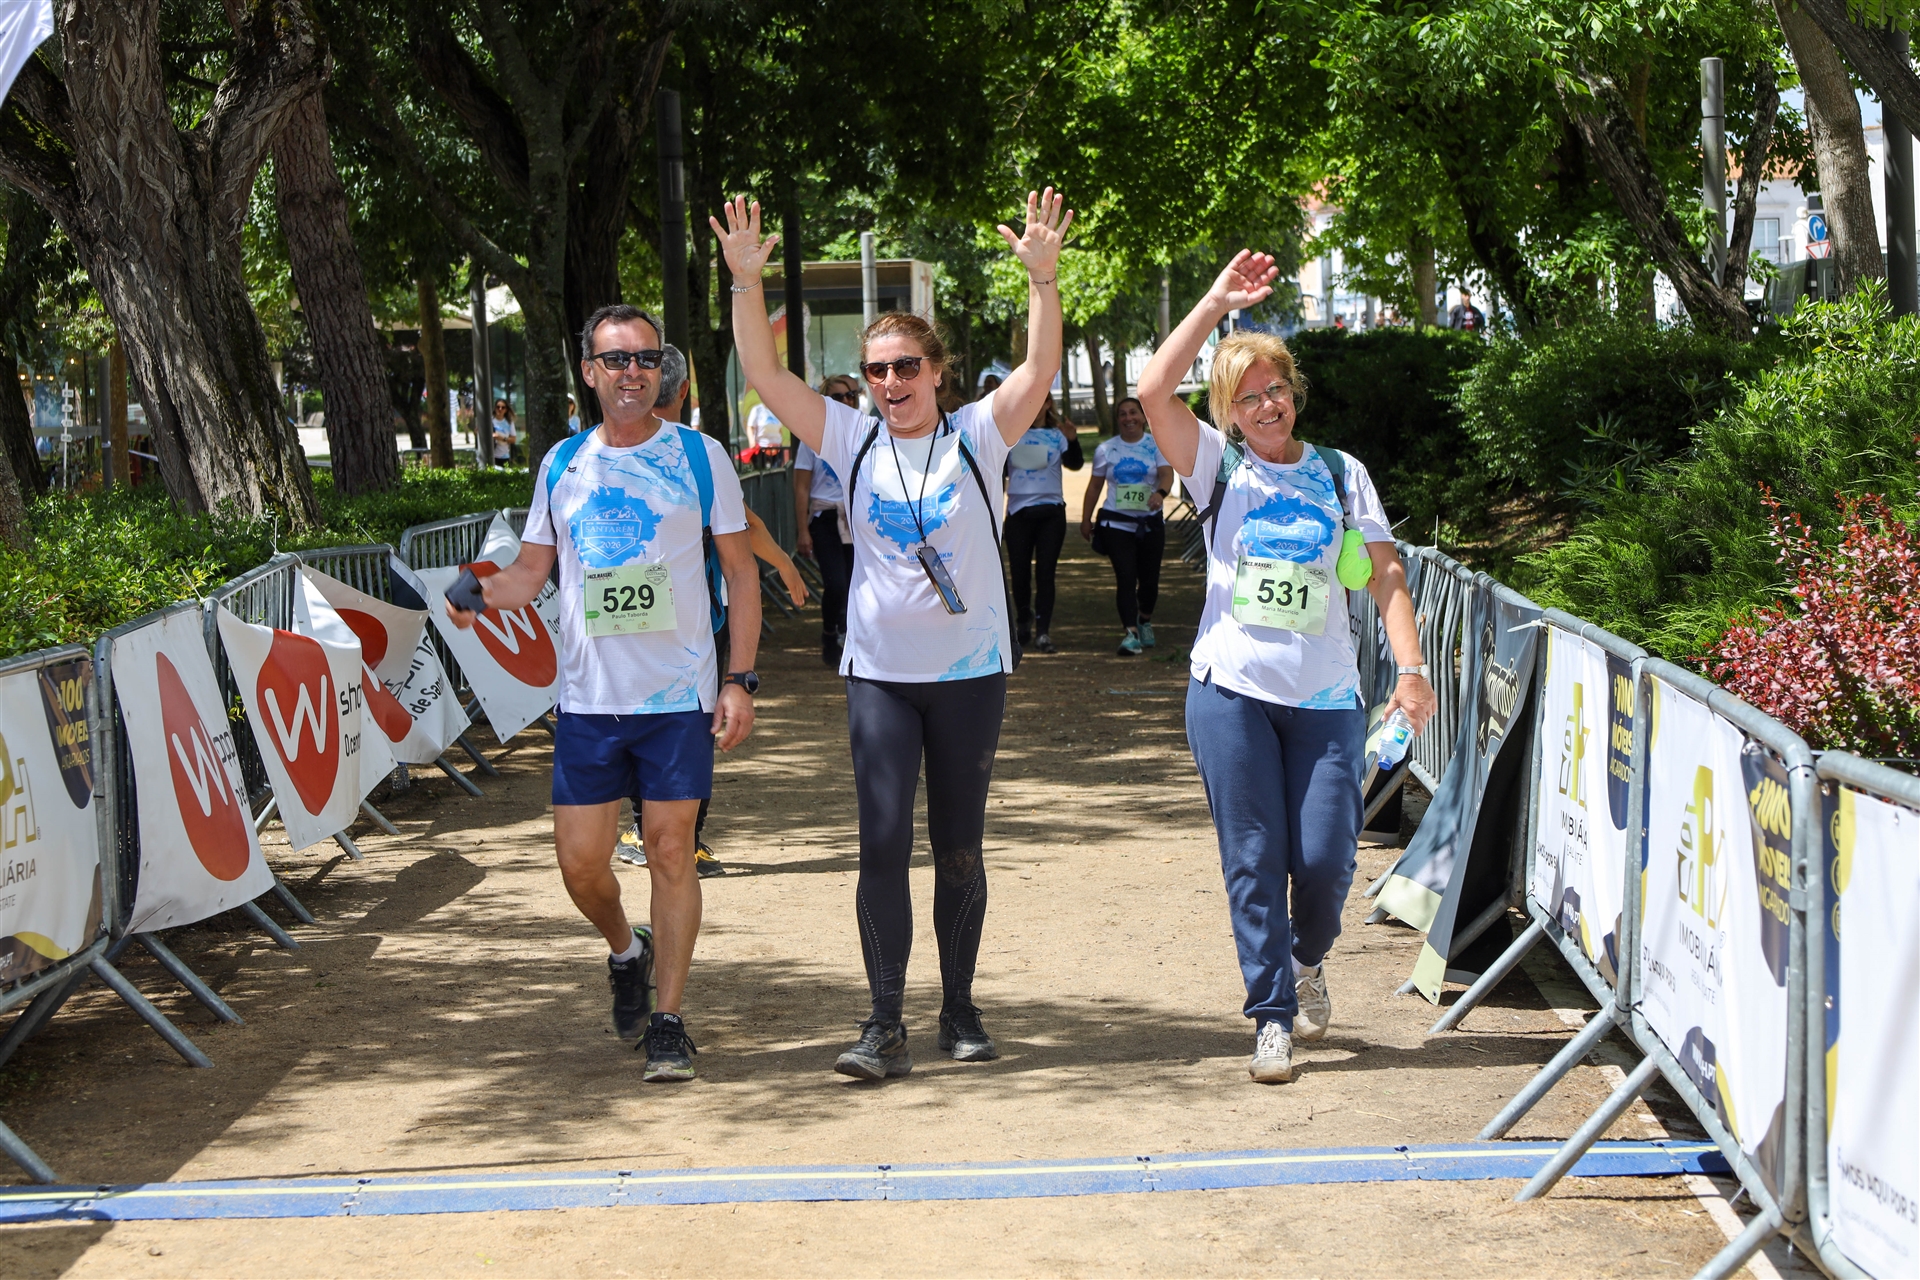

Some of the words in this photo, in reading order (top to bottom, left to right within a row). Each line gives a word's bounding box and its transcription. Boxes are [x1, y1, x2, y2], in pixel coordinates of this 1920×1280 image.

[1123, 491, 1145, 502] 478
[585, 524, 635, 533] SANTARÉM
[1260, 524, 1315, 537] SANTARÉM
[600, 541, 621, 549] 2026
[1275, 541, 1299, 551] 2026
[603, 584, 655, 613] 529
[1256, 578, 1309, 610] 531
[1749, 776, 1792, 841] +1000
